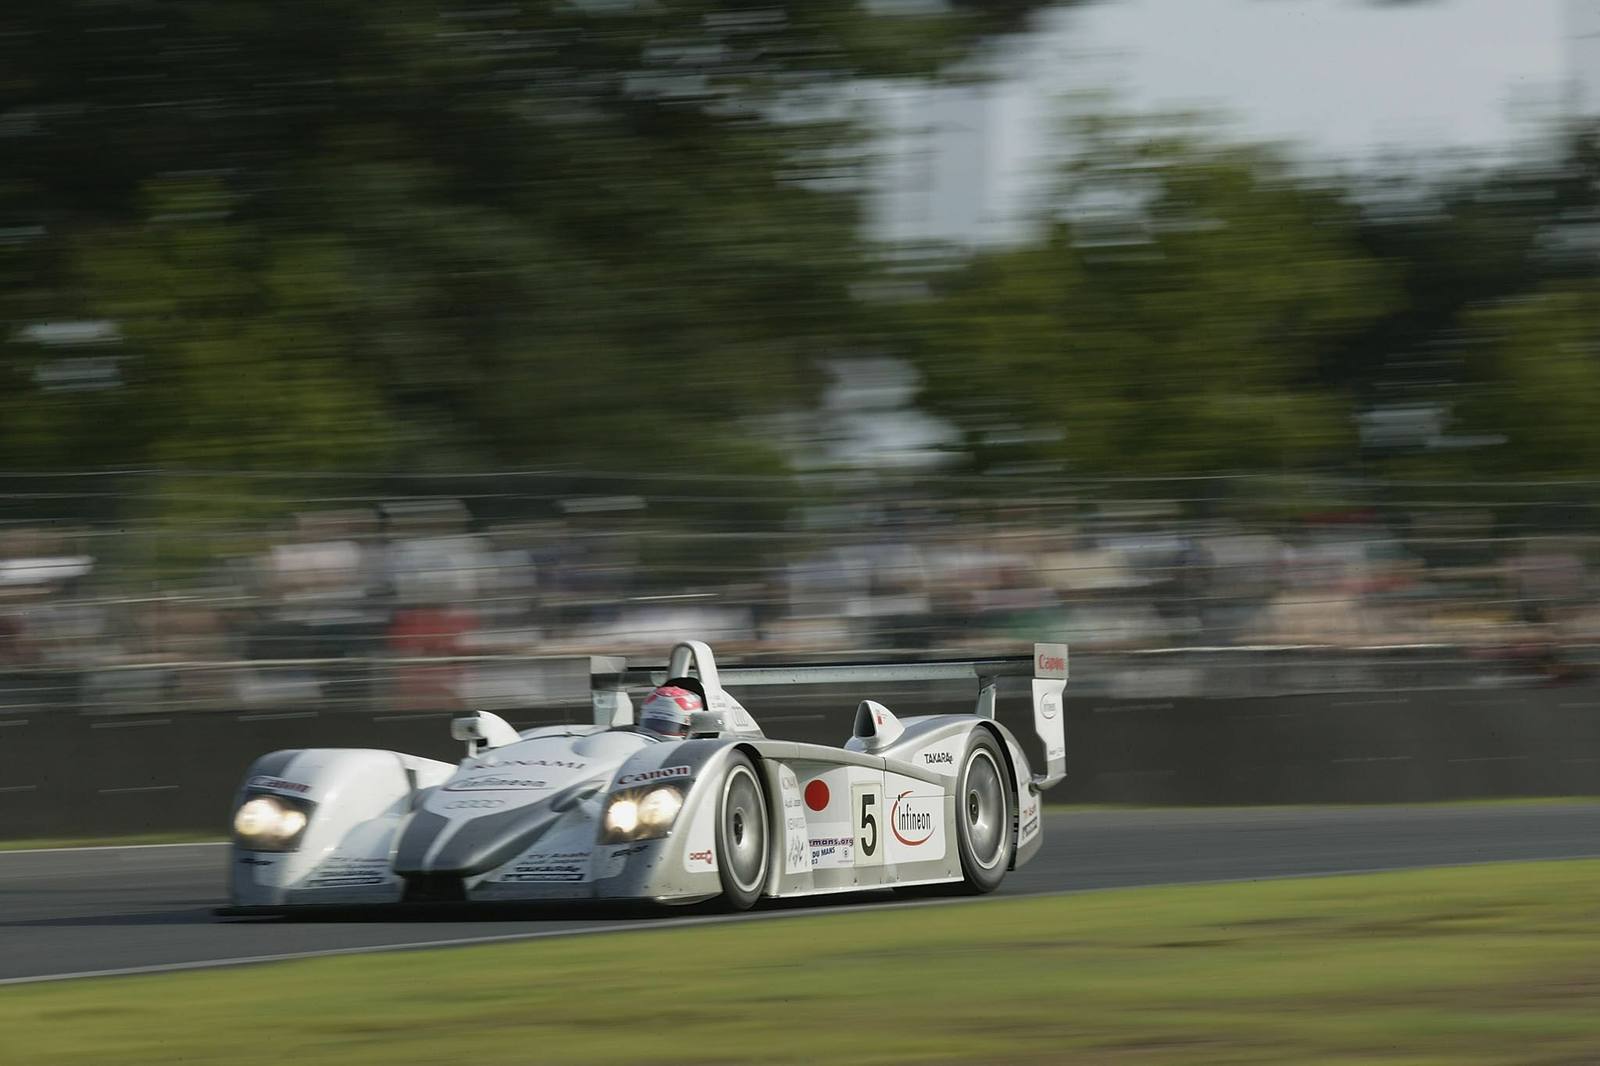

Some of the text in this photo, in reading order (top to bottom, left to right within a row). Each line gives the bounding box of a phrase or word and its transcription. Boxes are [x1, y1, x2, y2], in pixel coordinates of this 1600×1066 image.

[1039, 654, 1064, 671] Canon
[617, 766, 689, 785] Canon
[898, 794, 931, 831] Infineon
[861, 794, 877, 857] 5
[812, 846, 836, 859] DU MANS
